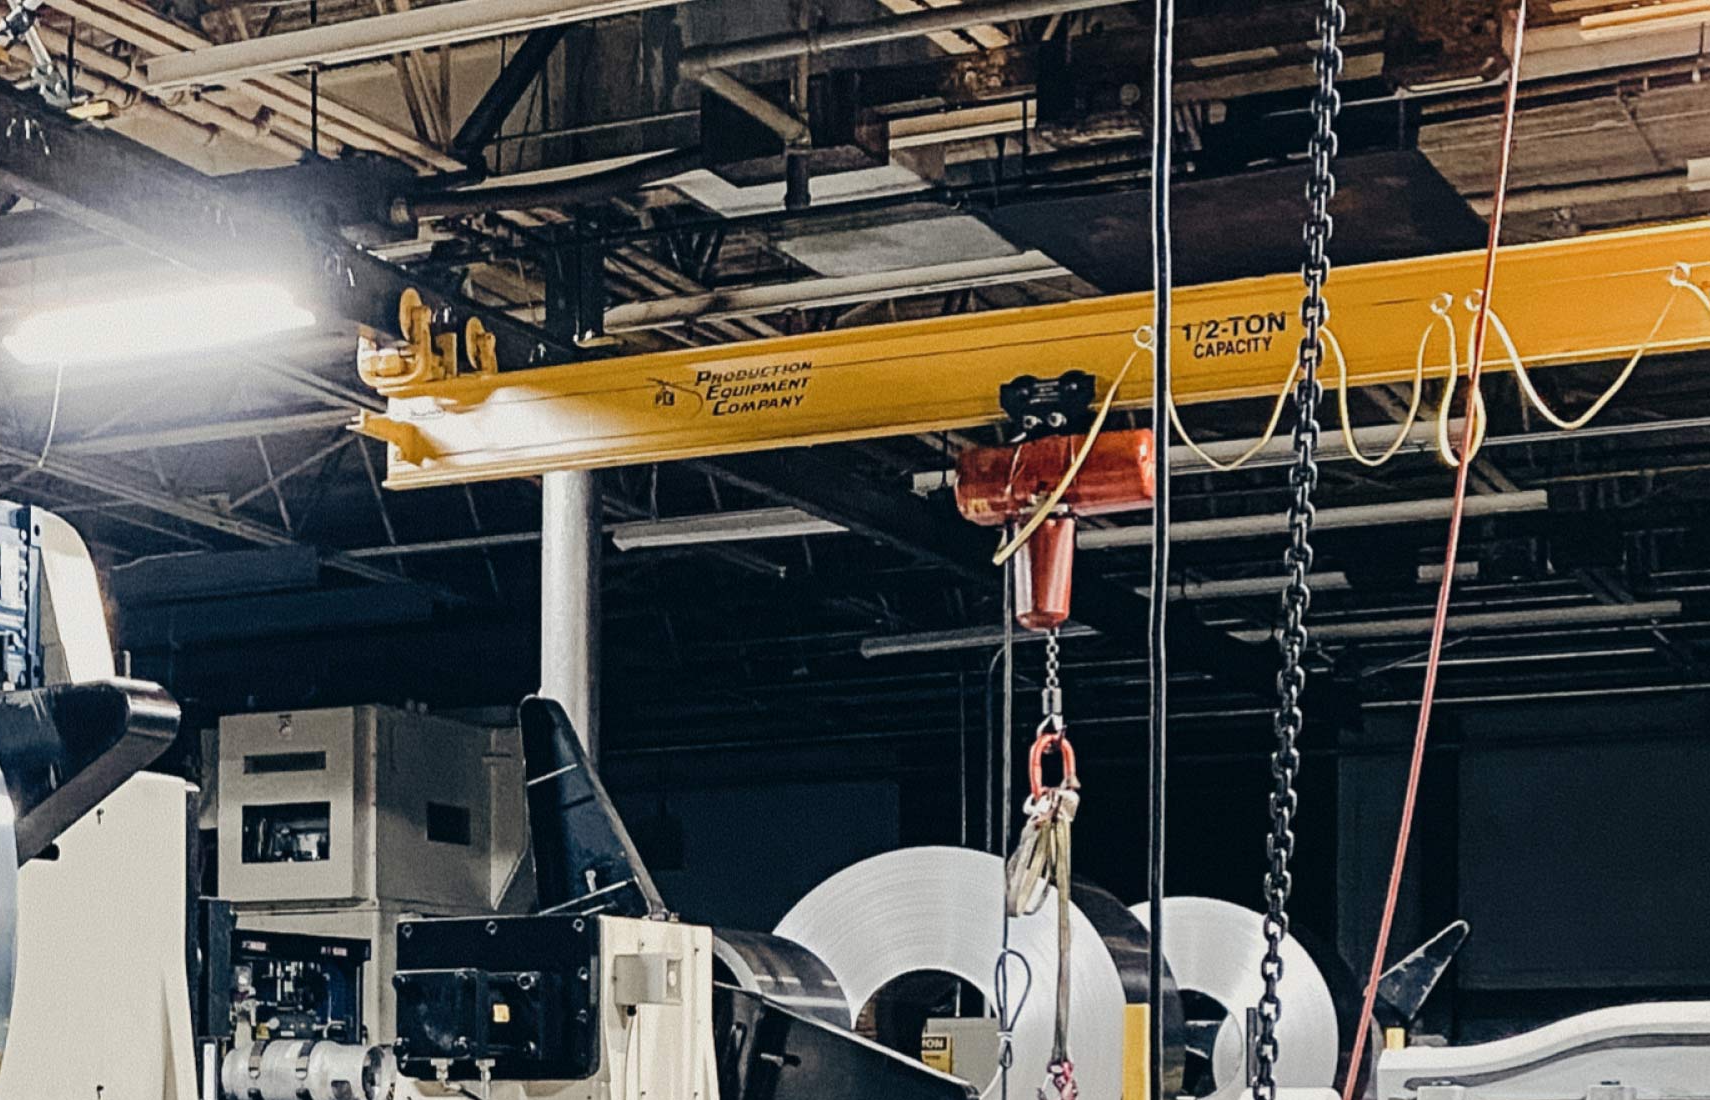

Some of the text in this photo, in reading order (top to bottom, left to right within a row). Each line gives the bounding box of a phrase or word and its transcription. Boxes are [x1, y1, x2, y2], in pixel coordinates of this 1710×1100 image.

[1182, 311, 1286, 341] 1/2-TON
[1194, 336, 1272, 359] CAPACITY
[695, 361, 812, 386] PRODUCTION
[706, 377, 811, 401] EQUIPMENT
[712, 394, 804, 416] COMPANY
